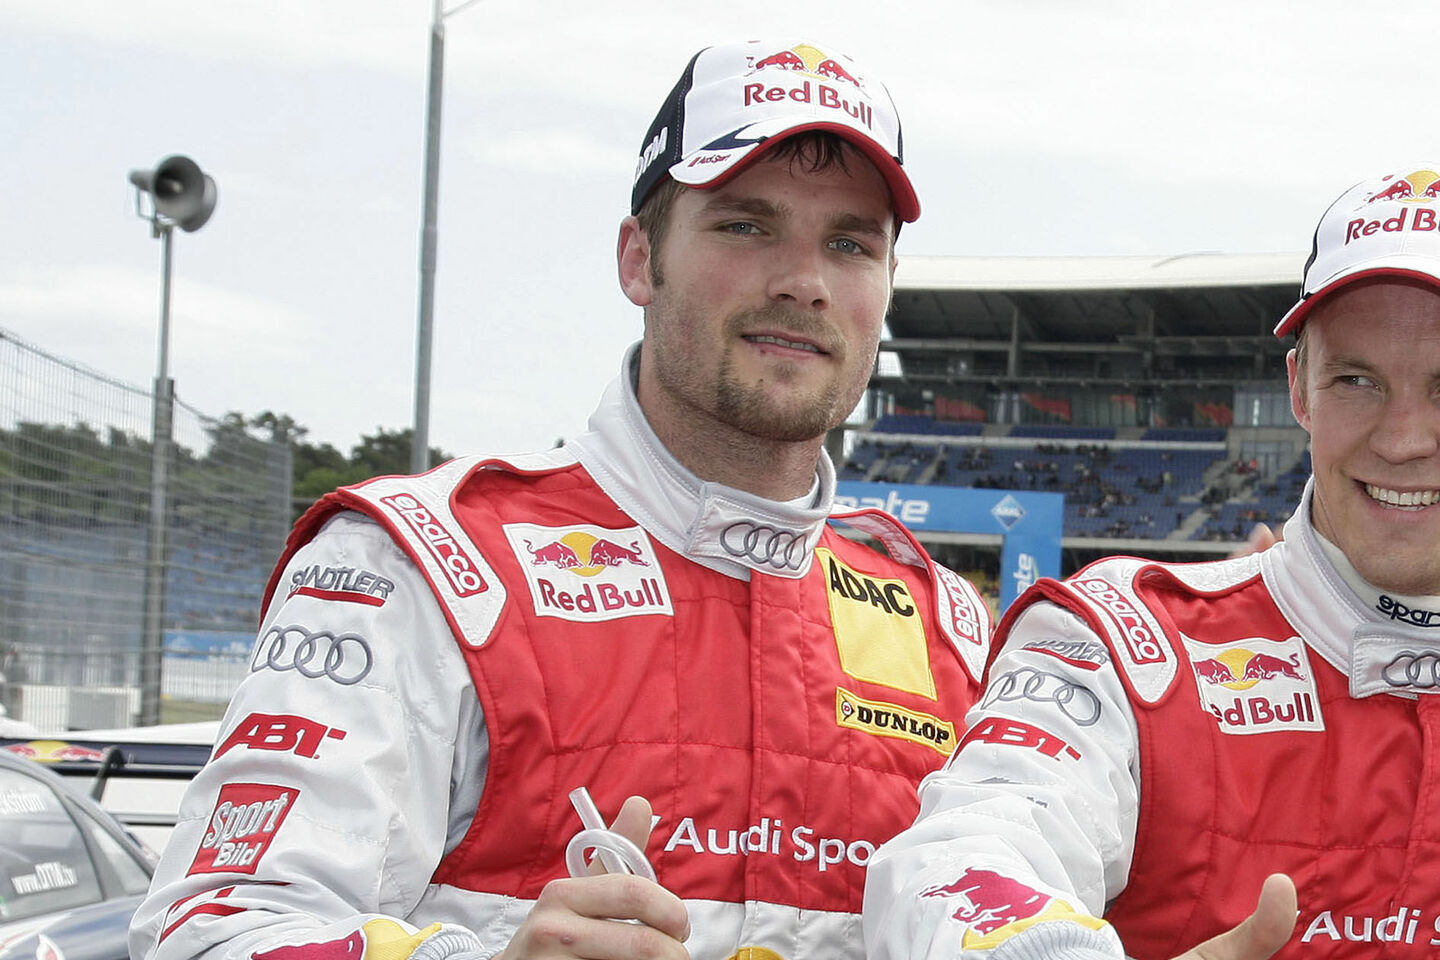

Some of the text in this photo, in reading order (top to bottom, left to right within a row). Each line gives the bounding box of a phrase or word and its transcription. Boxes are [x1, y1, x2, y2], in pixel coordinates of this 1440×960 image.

[744, 82, 873, 131] Red Bull
[1344, 208, 1408, 246] Red
[537, 578, 665, 613] Red Bull
[828, 556, 915, 617] ADAC
[857, 703, 950, 745] DUNLOP
[1247, 692, 1315, 726] Bull
[212, 712, 348, 760] ABT
[202, 791, 291, 850] Sport
[212, 841, 262, 869] Bild
[663, 816, 885, 873] Audi Spo
[1300, 906, 1421, 945] Audi
